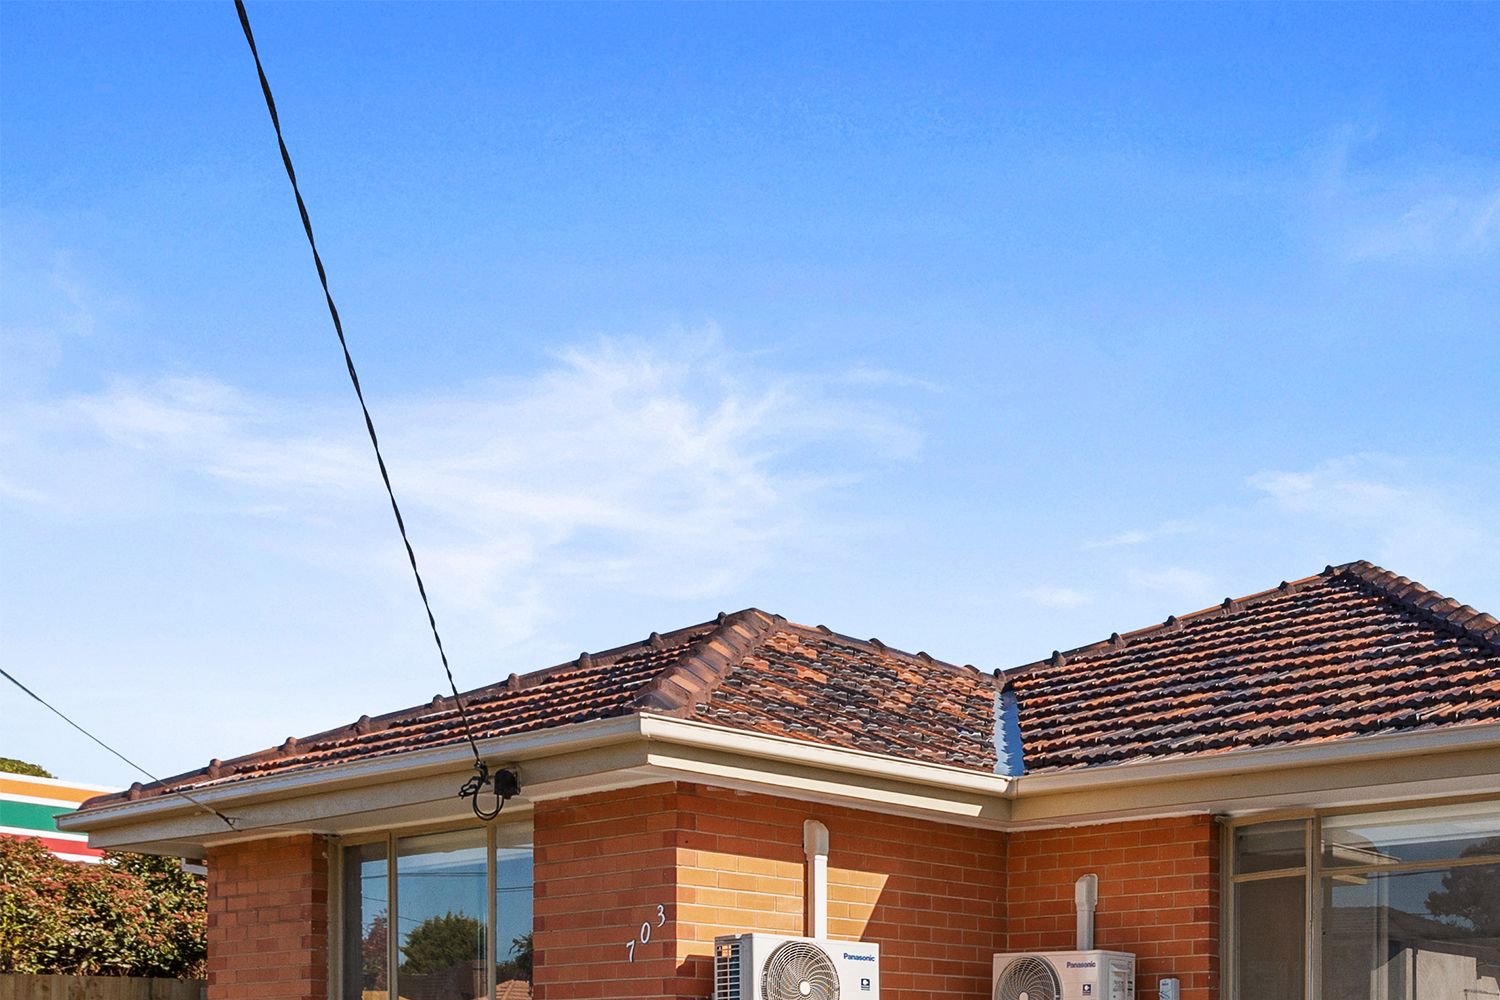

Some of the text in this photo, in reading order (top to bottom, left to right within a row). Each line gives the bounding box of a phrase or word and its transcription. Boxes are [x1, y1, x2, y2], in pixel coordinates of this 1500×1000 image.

[626, 904, 666, 963] 703
[843, 952, 875, 962] Panasonic
[1066, 961, 1096, 969] Panasonic
